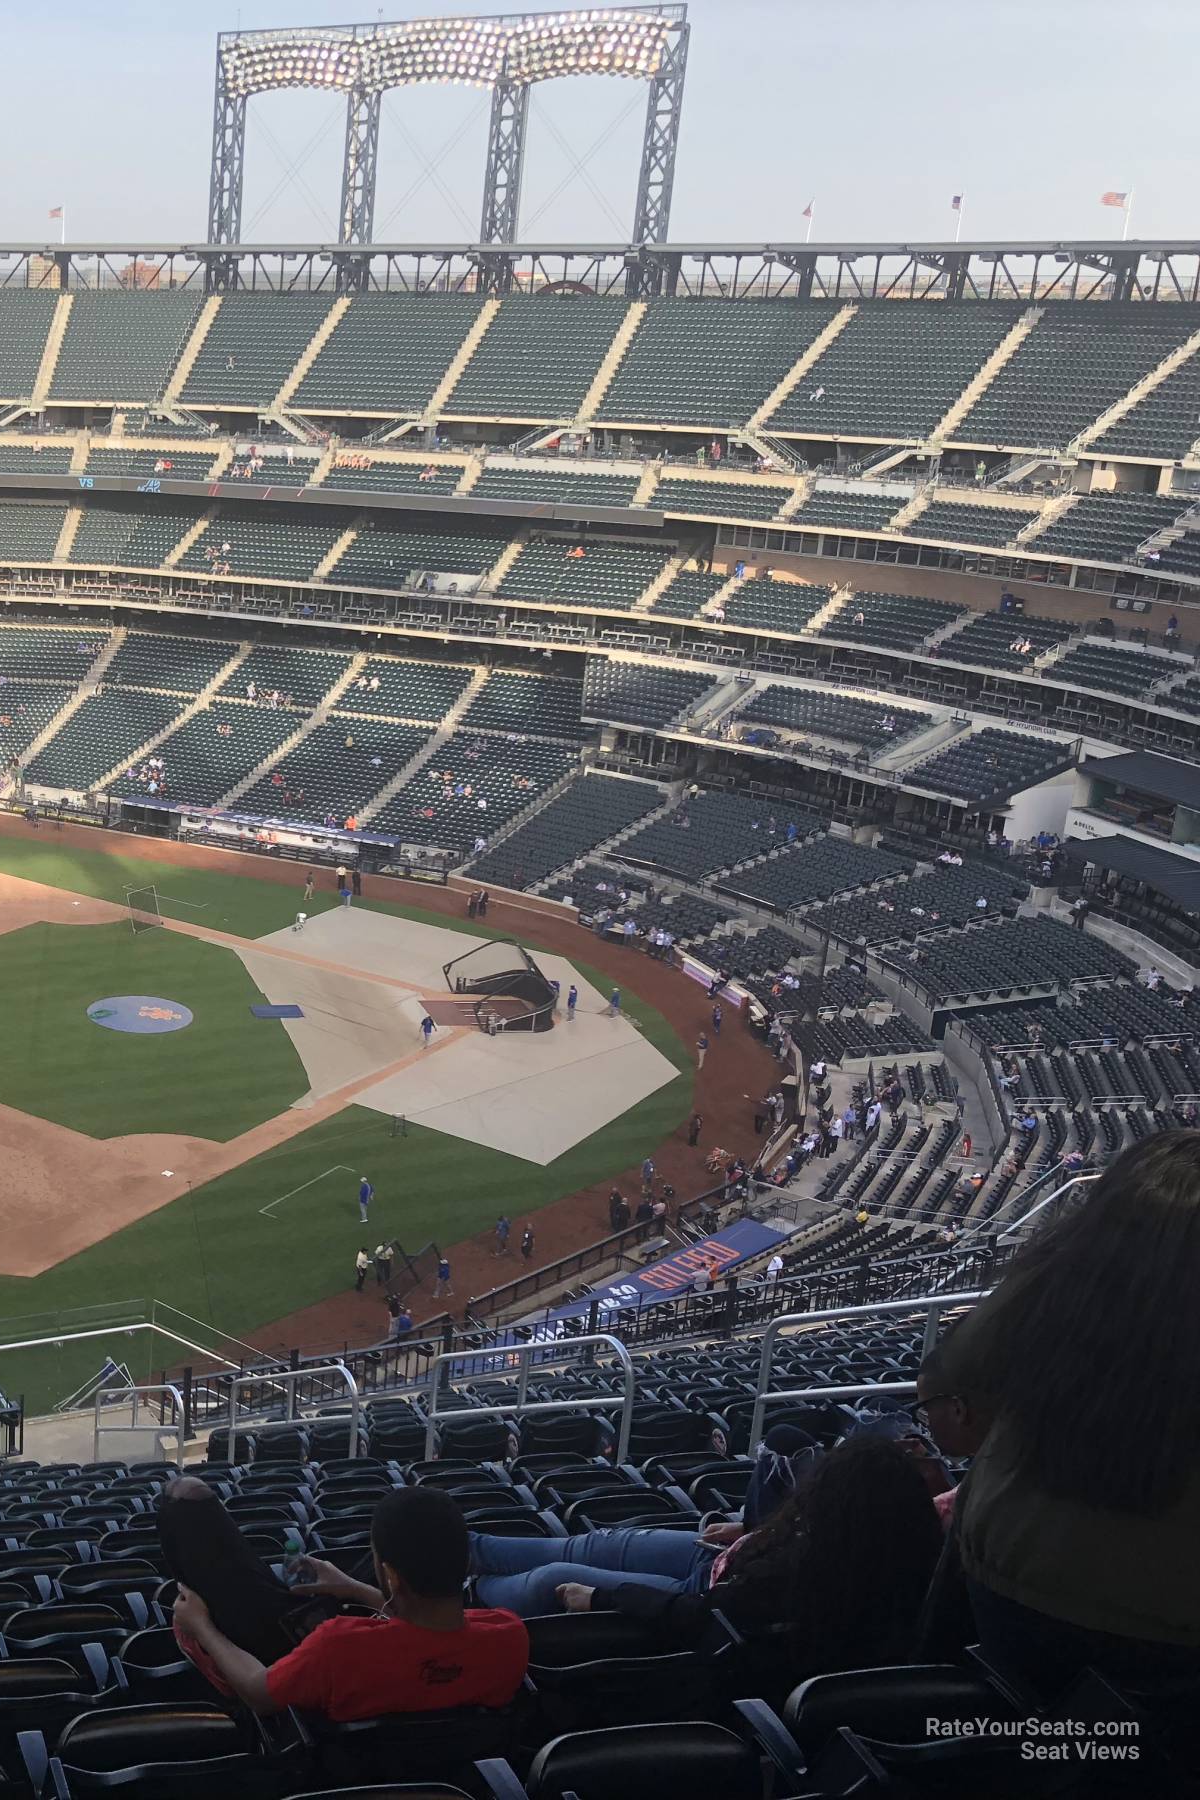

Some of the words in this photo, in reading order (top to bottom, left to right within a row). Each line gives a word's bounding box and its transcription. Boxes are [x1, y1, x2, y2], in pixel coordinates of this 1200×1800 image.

[79, 478, 94, 487] VS
[638, 1263, 689, 1290] CITI
[672, 1241, 740, 1271] FIELD
